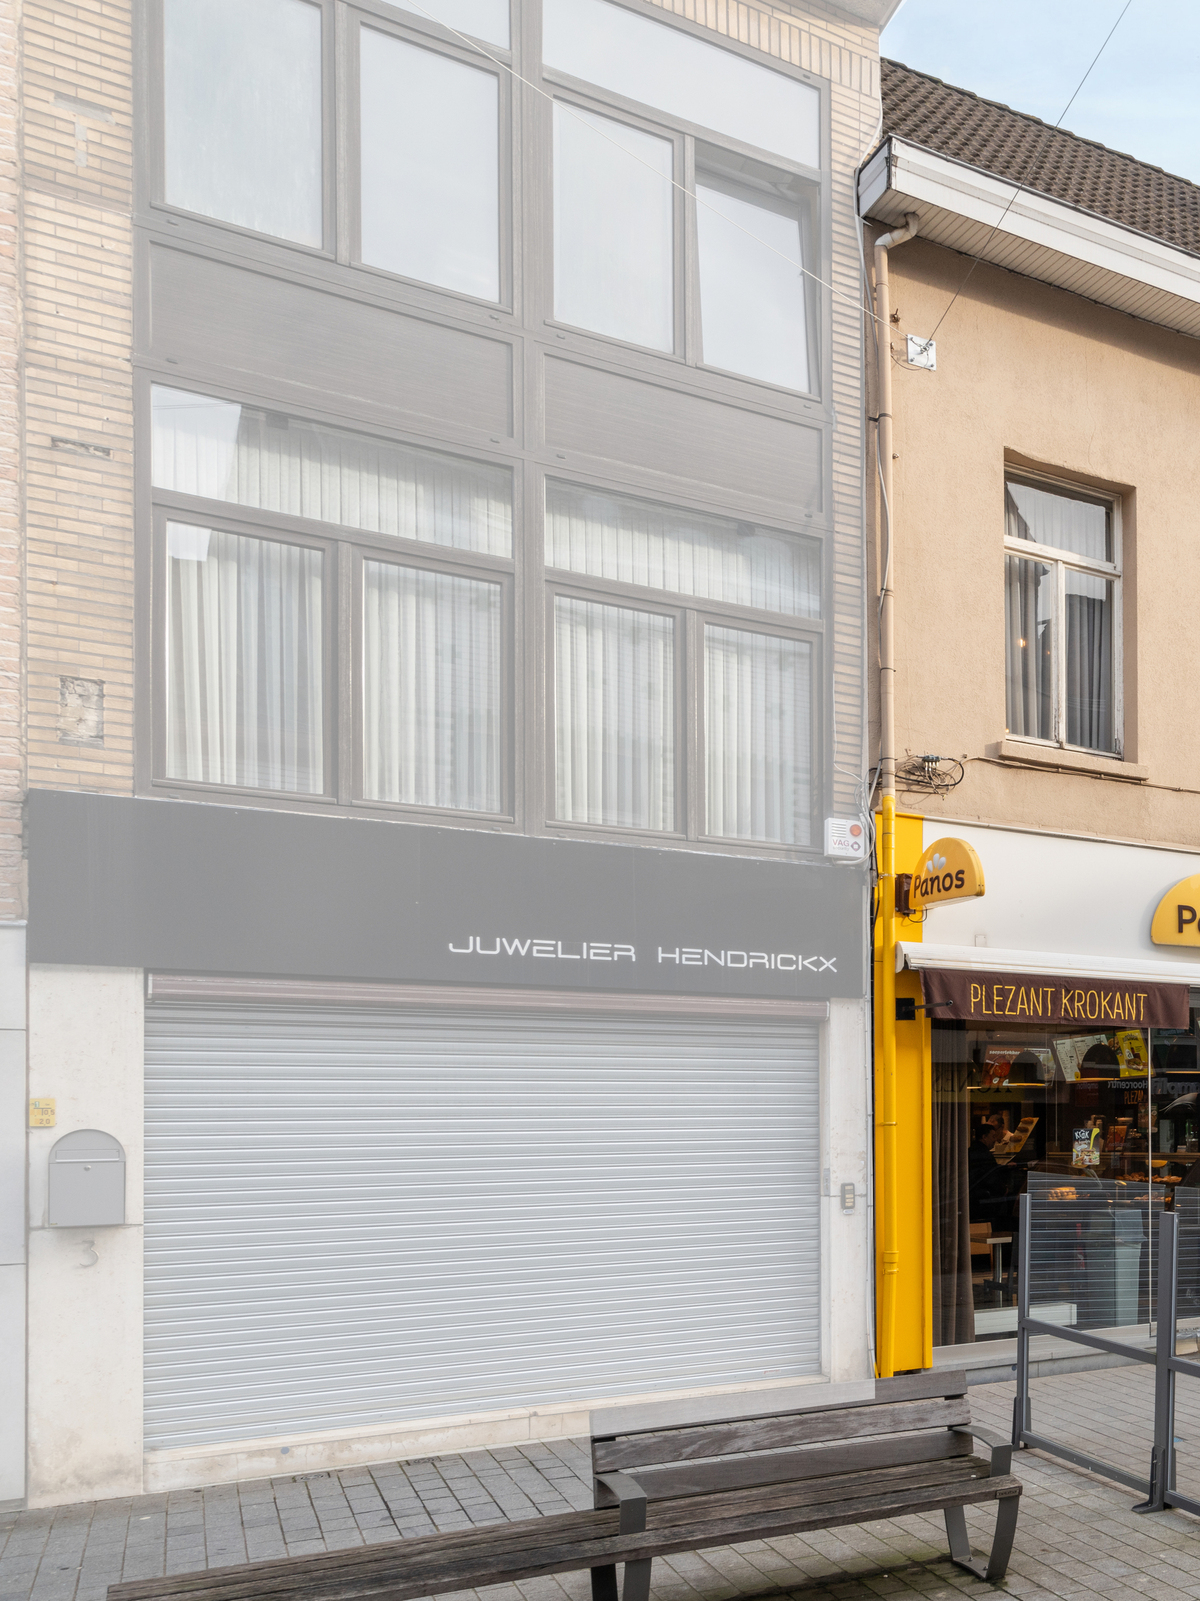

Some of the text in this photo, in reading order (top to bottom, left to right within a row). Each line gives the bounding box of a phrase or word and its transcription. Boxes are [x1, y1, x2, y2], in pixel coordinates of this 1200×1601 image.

[832, 839, 850, 847] VAG
[914, 870, 965, 898] Panos
[448, 936, 838, 973] JUWELIER HENDRICKX
[970, 983, 1148, 1021] PLEZANT KROKANT
[80, 1239, 99, 1268] 3
